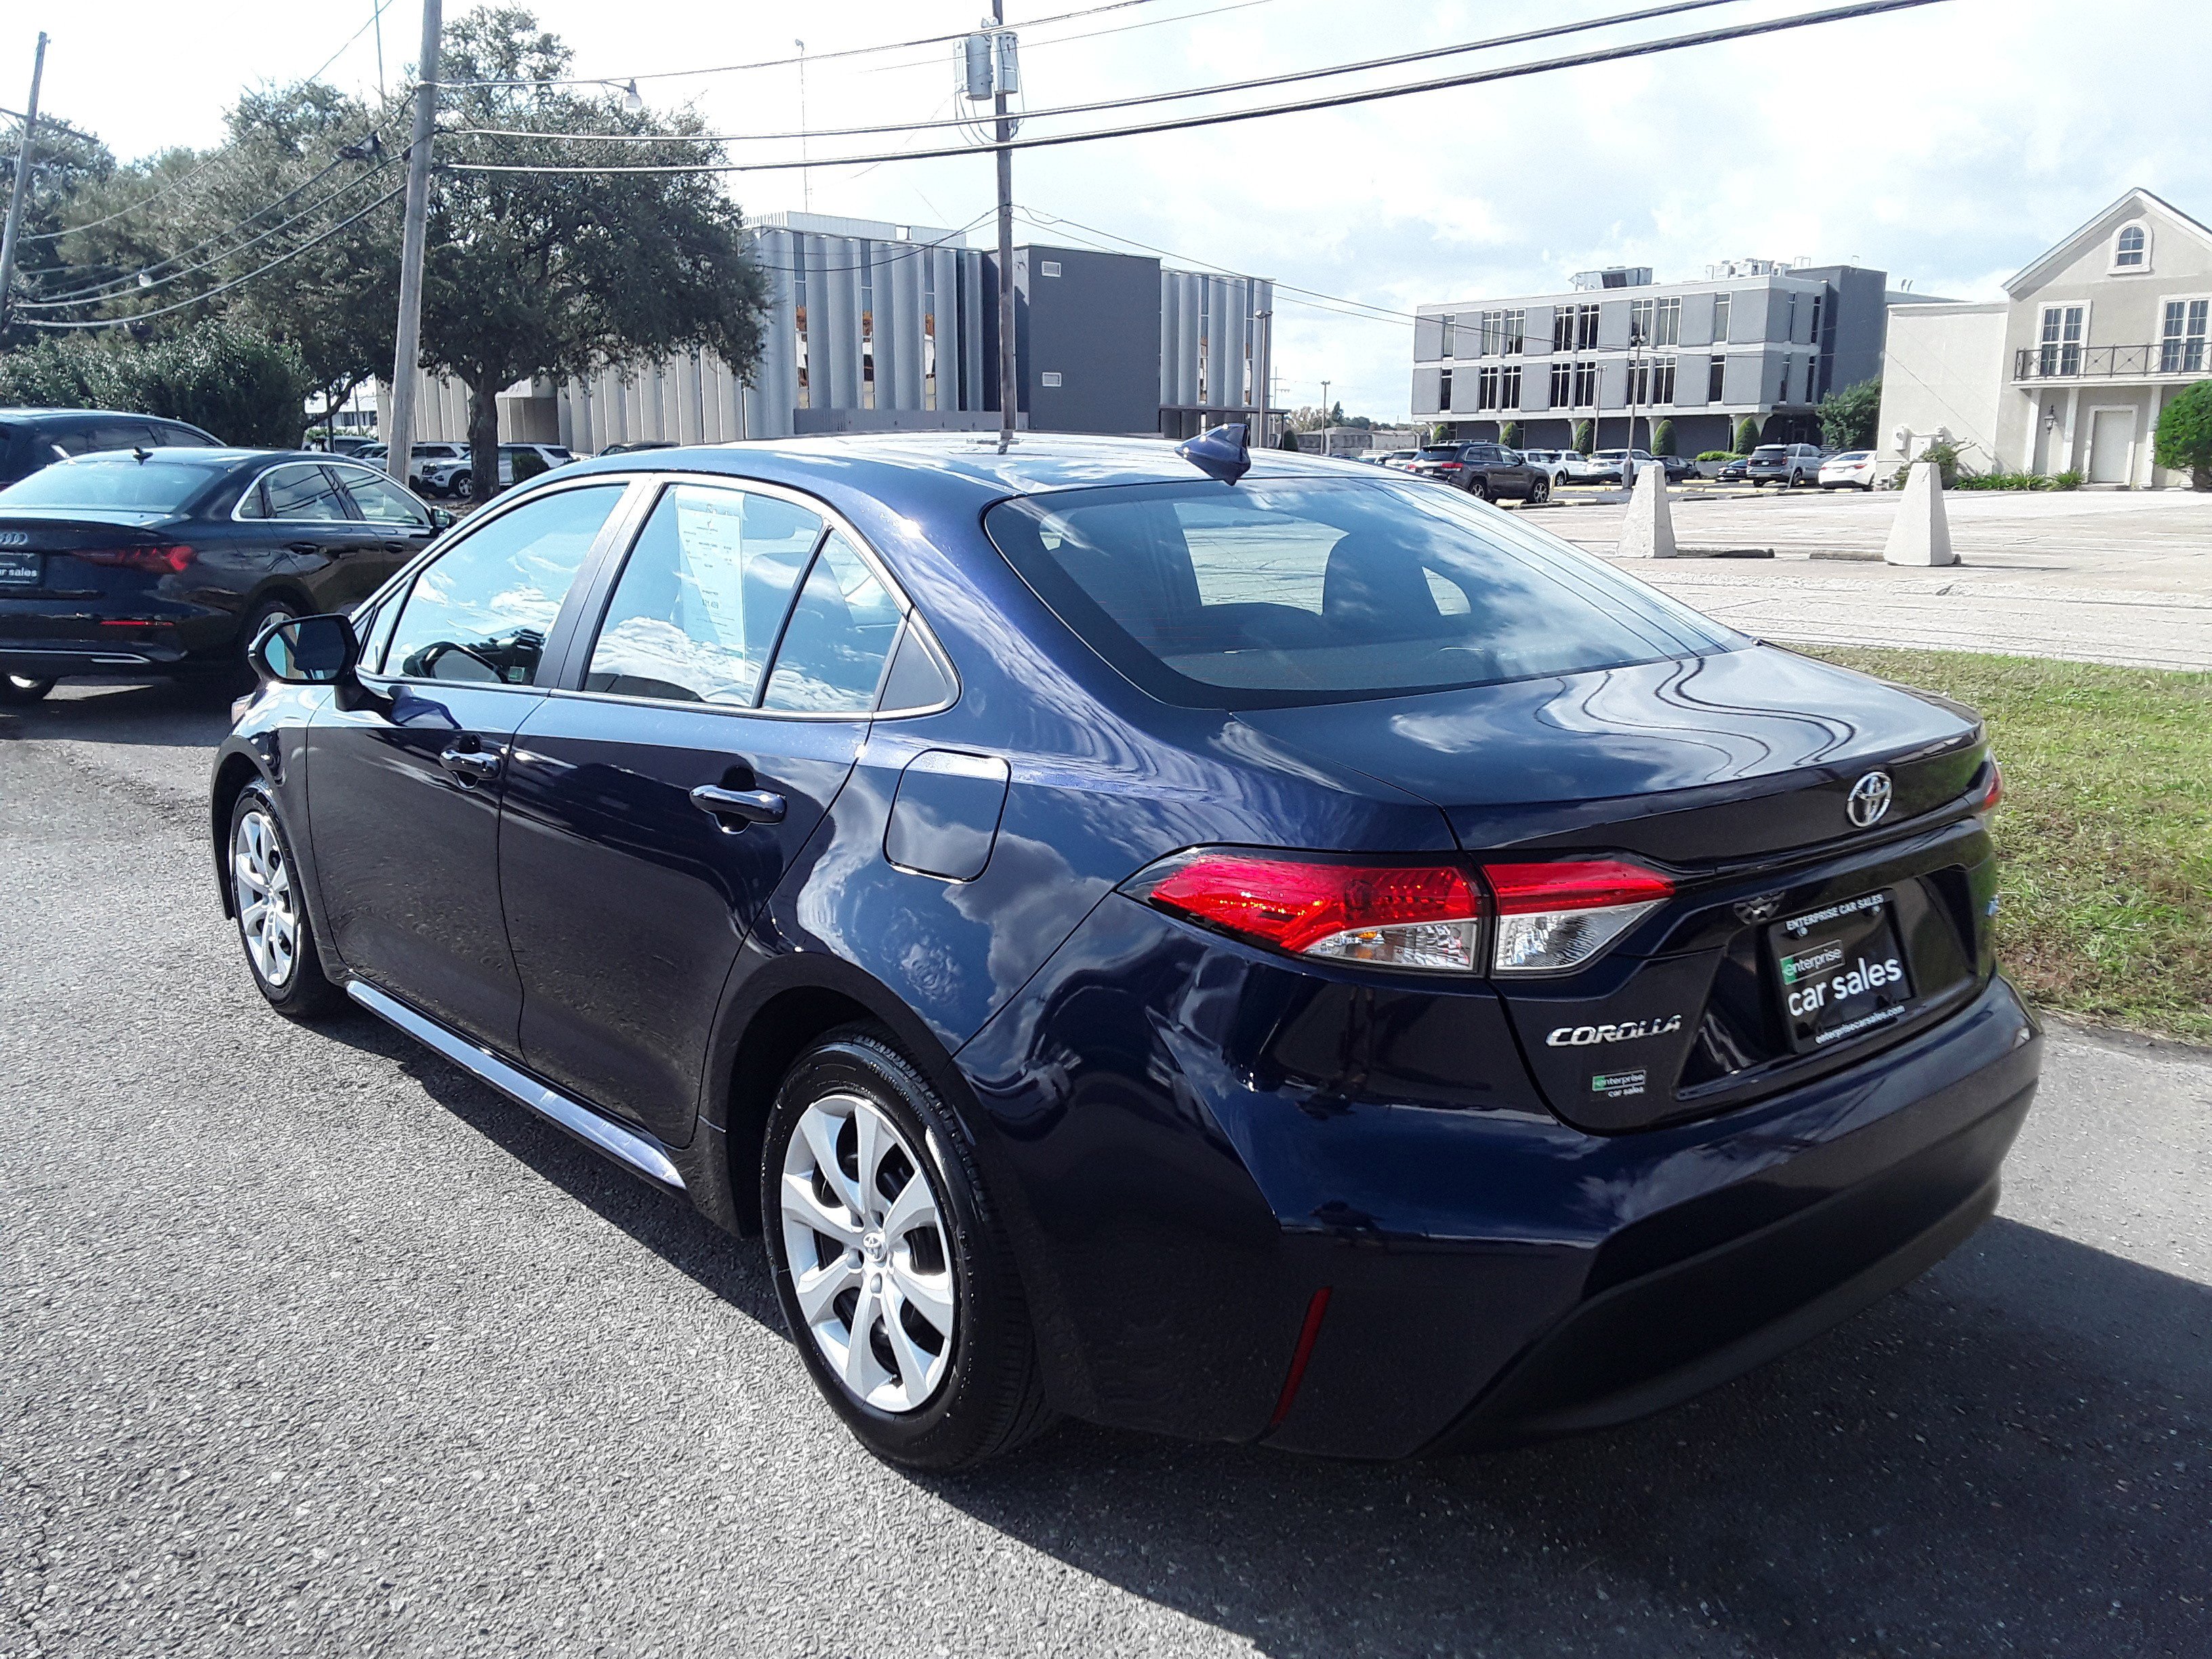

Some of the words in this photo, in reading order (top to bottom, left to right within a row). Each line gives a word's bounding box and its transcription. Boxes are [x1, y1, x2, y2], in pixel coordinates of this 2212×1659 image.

[1786, 907, 1839, 930] ENTERPRISE
[1839, 901, 1857, 914] CAR
[1857, 894, 1884, 909] SALES
[1782, 948, 1842, 976] enterprise
[1788, 982, 1827, 1017] car
[1832, 957, 1902, 1000] sales
[1545, 1014, 1682, 1046] COROLLA
